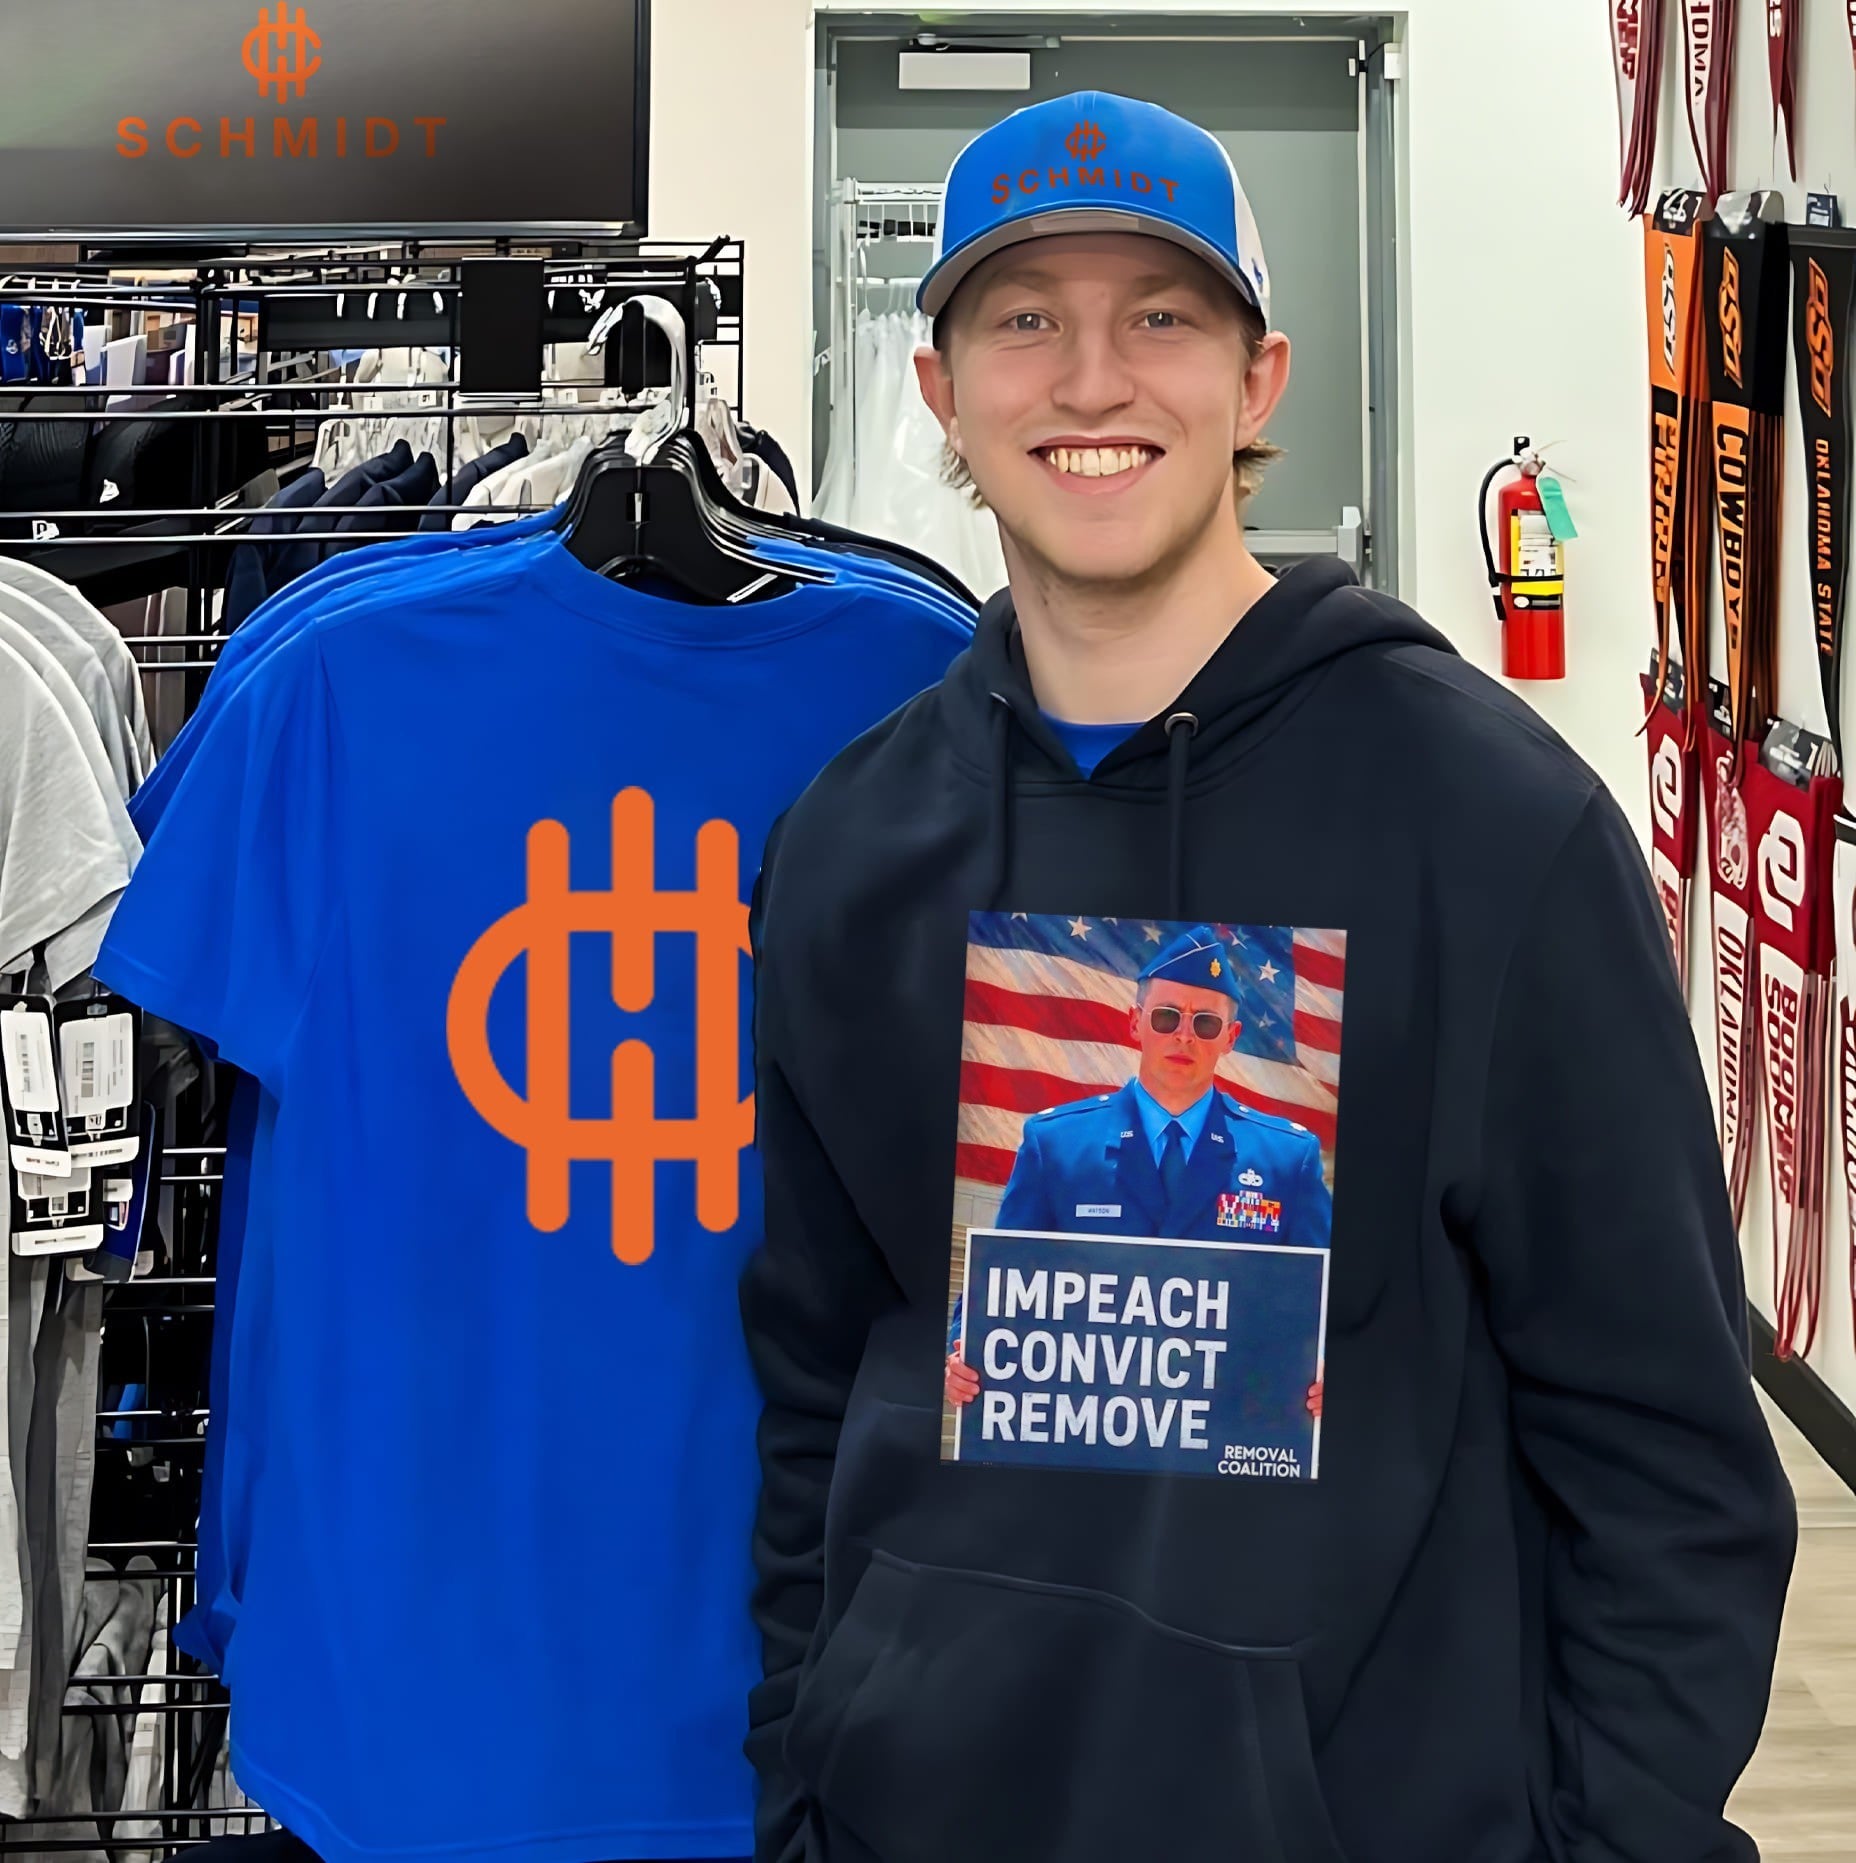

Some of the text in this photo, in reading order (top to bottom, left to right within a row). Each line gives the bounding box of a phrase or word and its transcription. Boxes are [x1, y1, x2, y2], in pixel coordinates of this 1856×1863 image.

[116, 116, 447, 159] SCHMIDT
[991, 166, 1180, 204] SCHMIDT
[985, 1266, 1230, 1331] IMPEACH
[982, 1327, 1228, 1390] CONVICT
[981, 1389, 1211, 1450] REMOVE
[1216, 1460, 1301, 1478] COALITION
[1223, 1444, 1298, 1463] REMOVAL
